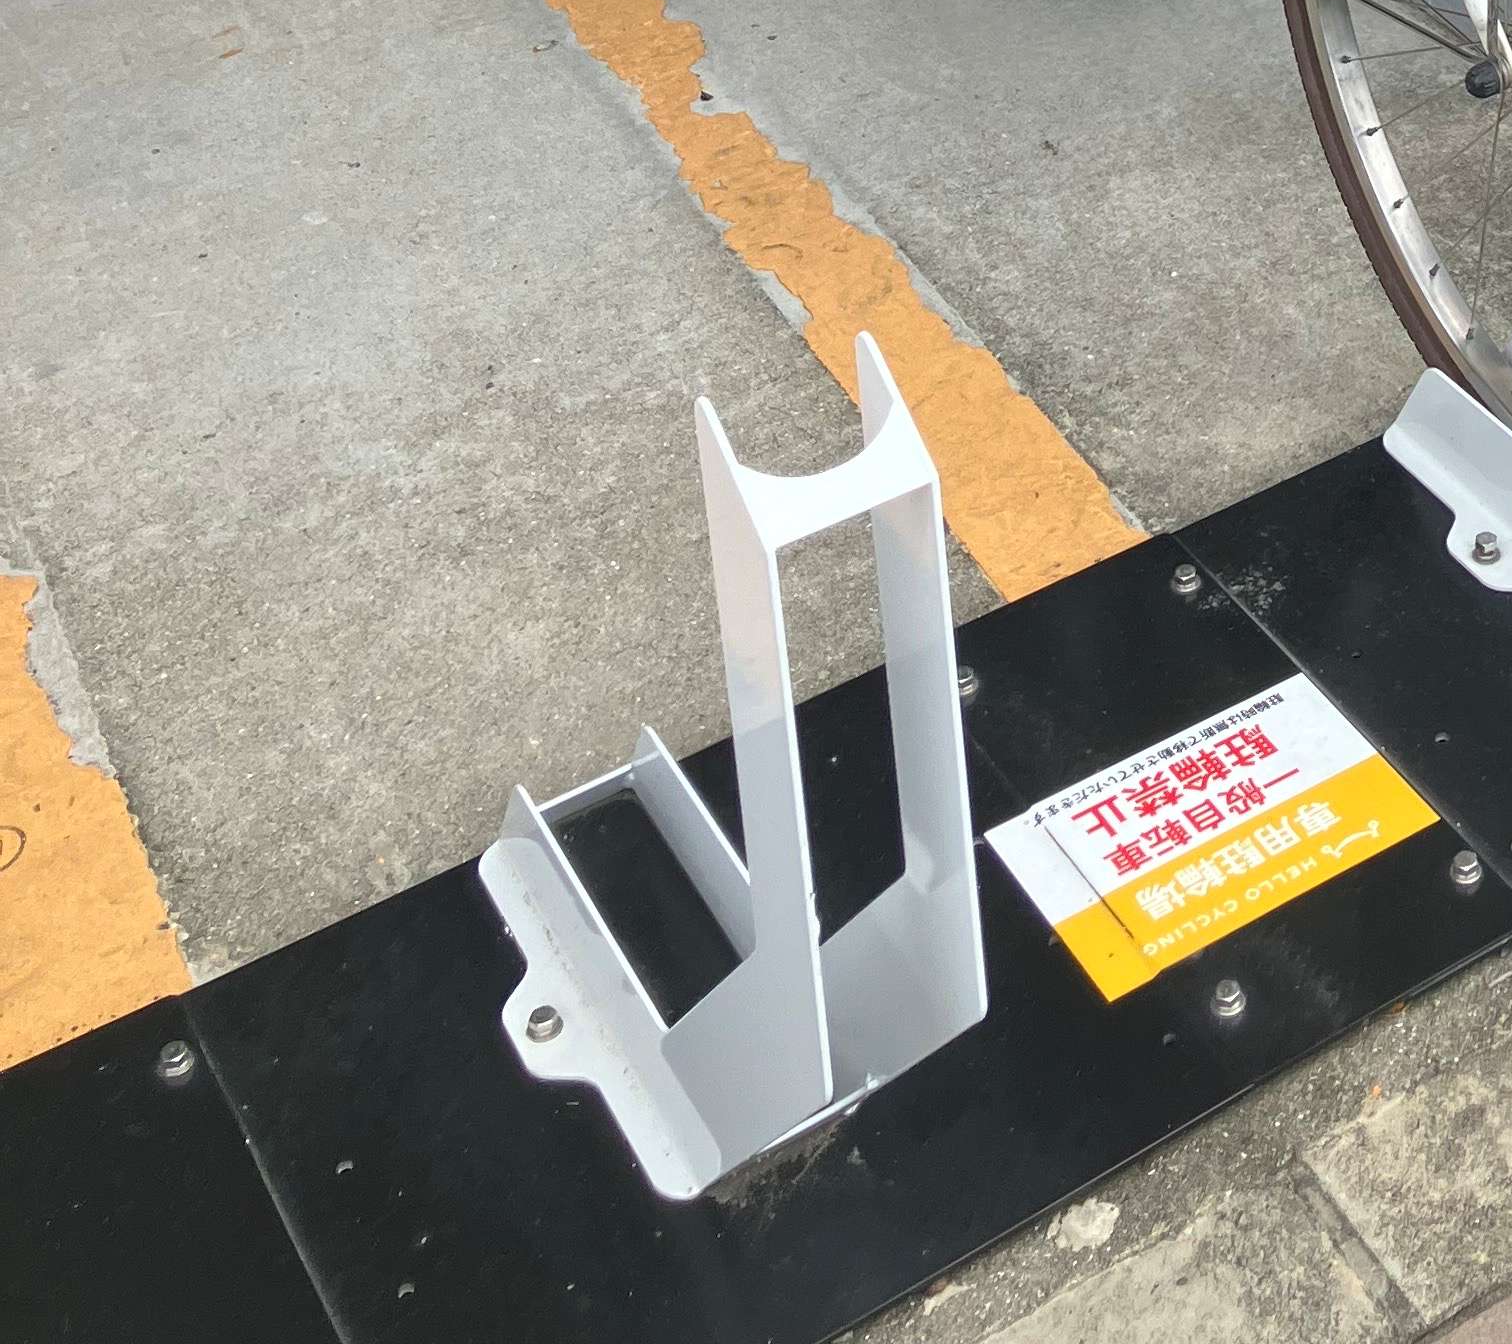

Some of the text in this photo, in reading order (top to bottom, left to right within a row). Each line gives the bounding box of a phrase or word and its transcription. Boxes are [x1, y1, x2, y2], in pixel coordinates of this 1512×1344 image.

[1071, 723, 1281, 838] 駐輪禁止
[1102, 767, 1300, 877] 一般自転車
[1134, 798, 1342, 922] 専用駐輪場
[1142, 857, 1318, 956] HELLO CYCLING
